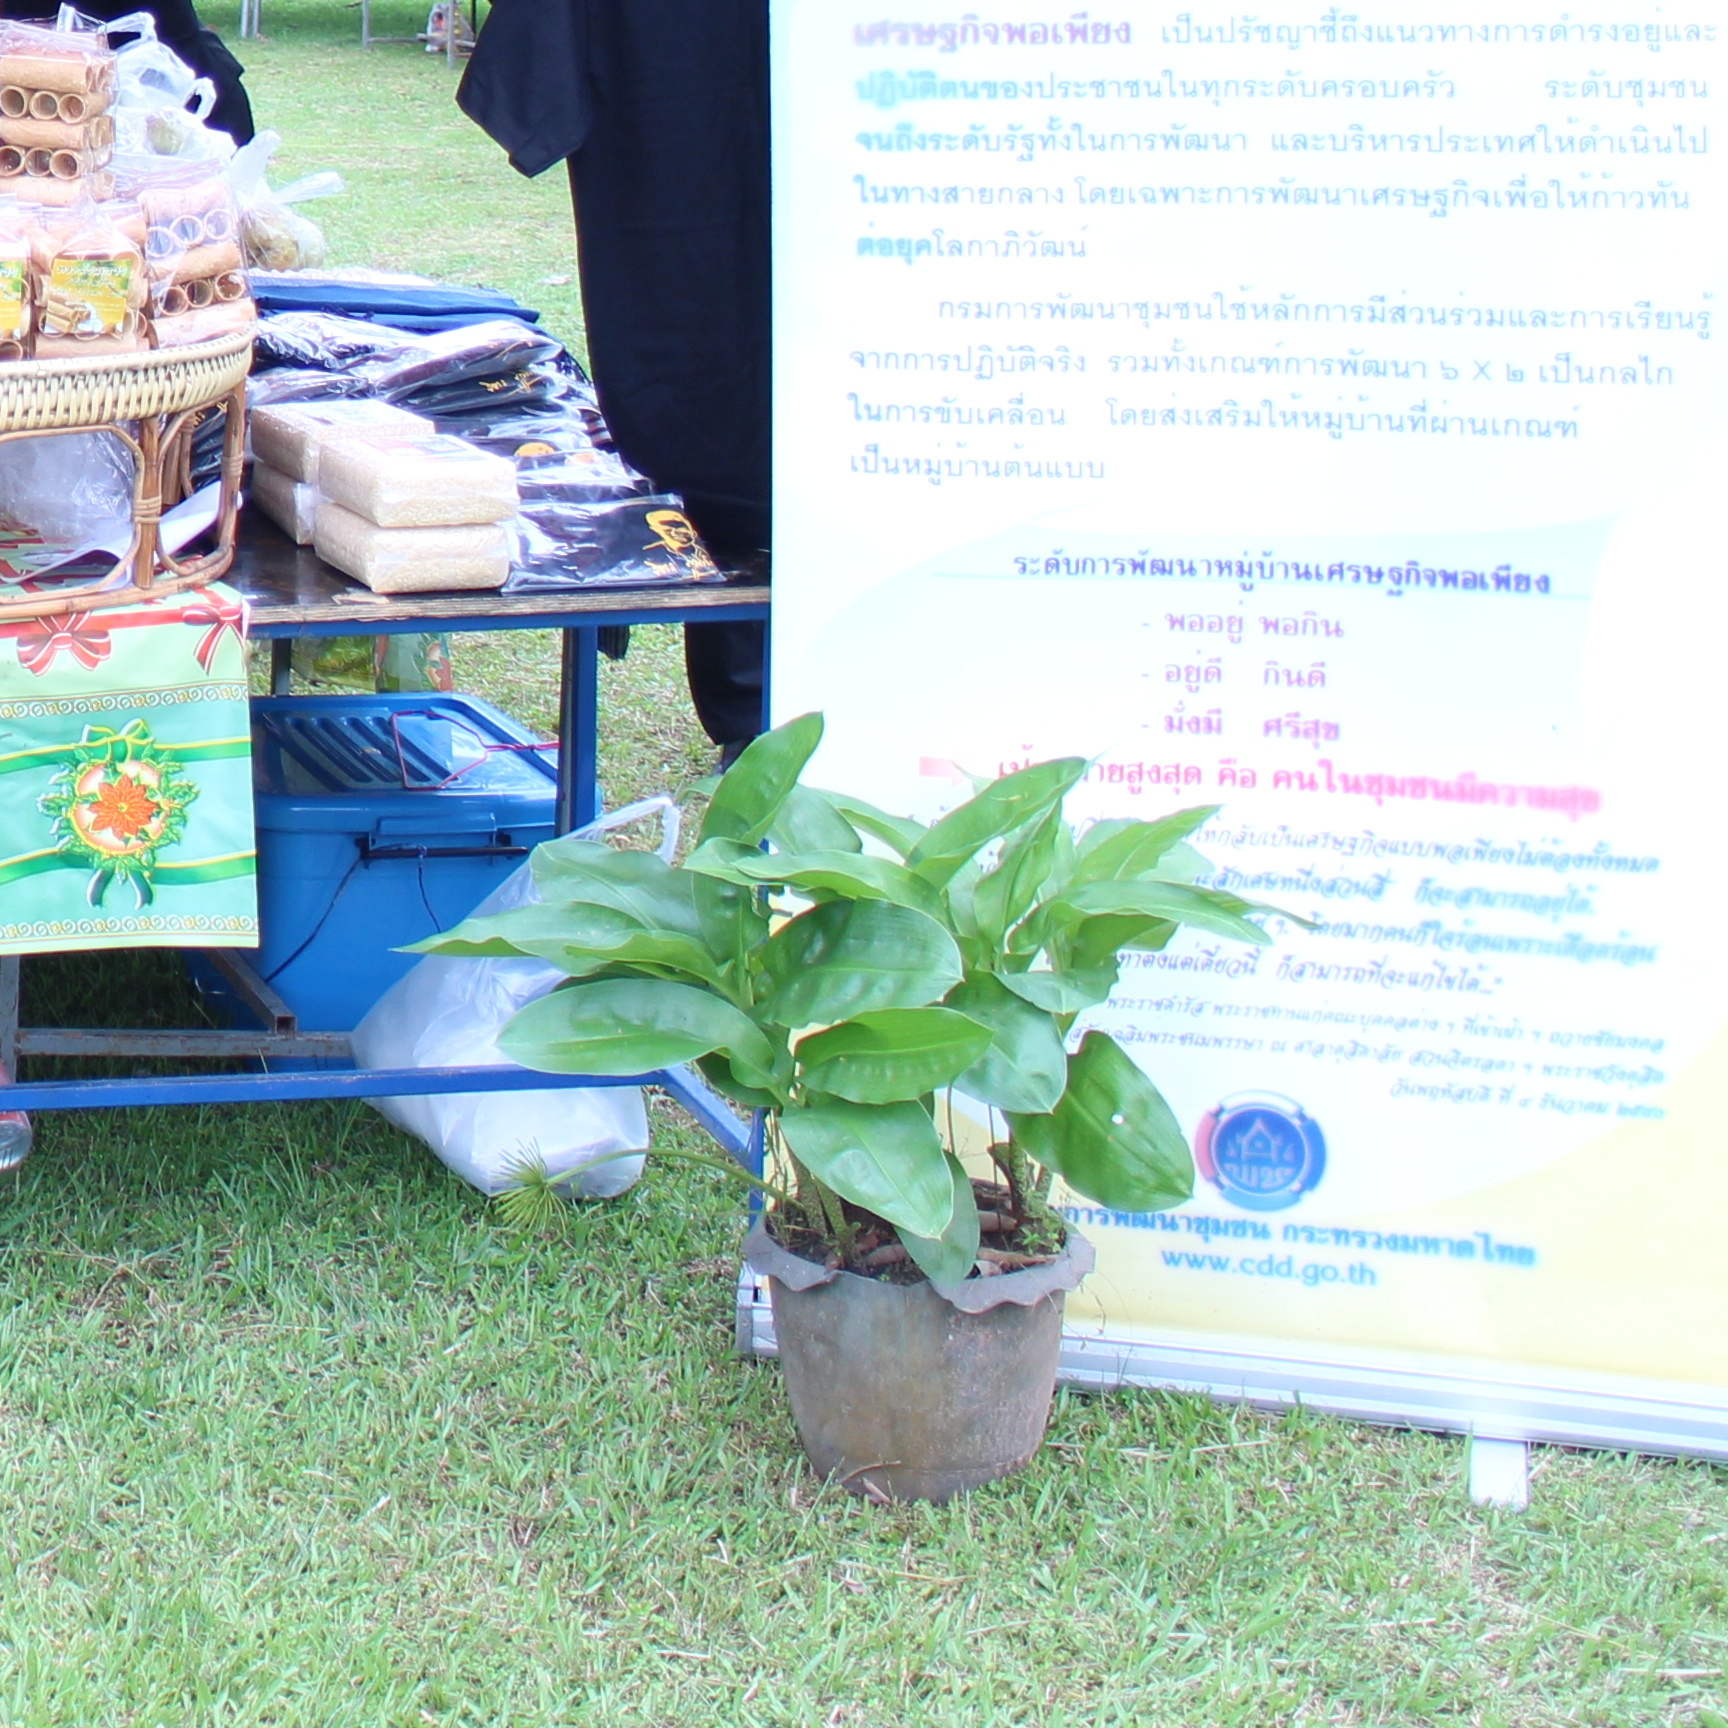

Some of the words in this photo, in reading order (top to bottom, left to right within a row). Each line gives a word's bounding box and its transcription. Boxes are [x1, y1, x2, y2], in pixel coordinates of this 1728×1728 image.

[1543, 69, 1708, 108] ระดับชุมชน
[853, 174, 1064, 208] ในทางสายกลาง
[849, 344, 1086, 382] จากการปฏิบัติจริง
[1537, 350, 1675, 389] เป็นกลไก
[847, 389, 1067, 429] ในการขับเคลื่อน
[849, 443, 1106, 485] เป็นหมู่บ้านต้นแบบ
[1165, 599, 1244, 644] พออยู่
[1260, 610, 1346, 640] พอกิน
[1164, 648, 1224, 693] อยู่ดี
[1263, 660, 1328, 689] กินดี
[1164, 700, 1225, 736] มั่งมี
[1262, 713, 1343, 750] ศรีสุข
[1218, 758, 1258, 790] คือ
[1161, 1245, 1377, 1287] www.cdd.go.th
